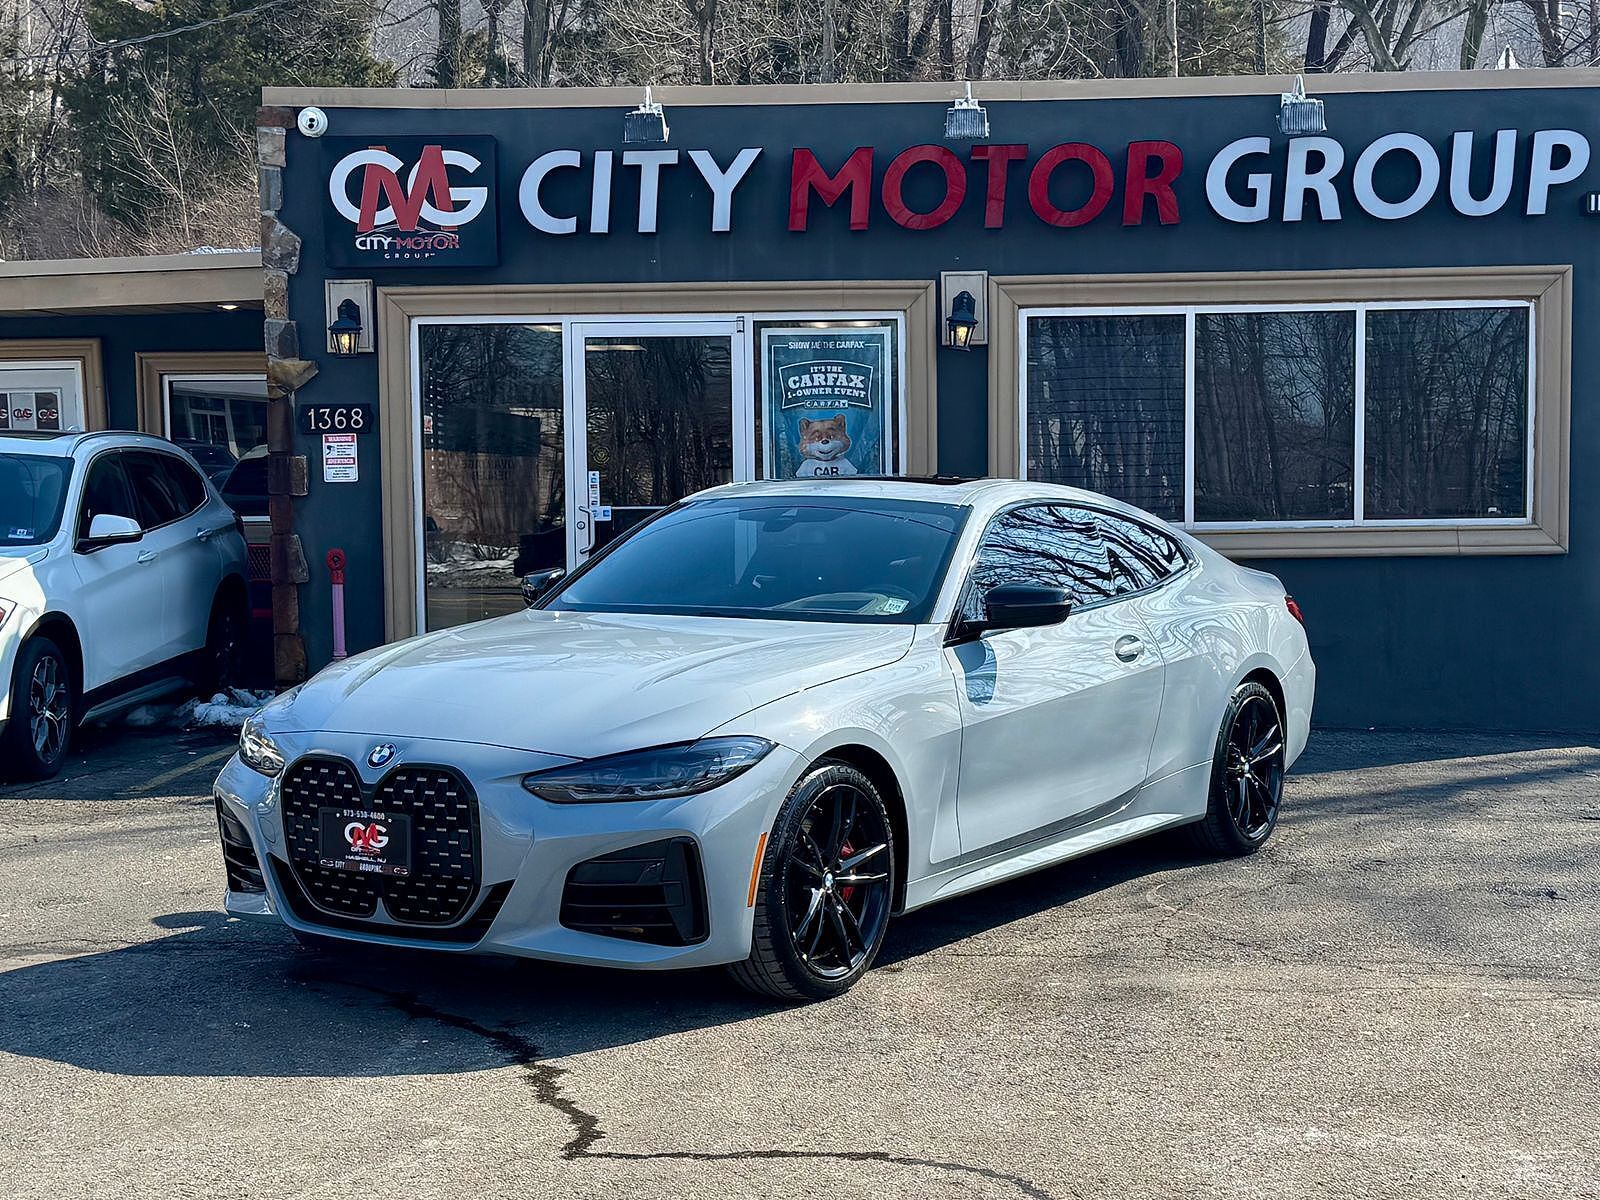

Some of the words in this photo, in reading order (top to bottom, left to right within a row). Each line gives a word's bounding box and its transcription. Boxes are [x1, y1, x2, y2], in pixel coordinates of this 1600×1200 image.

[518, 147, 763, 235] CITY
[787, 140, 1184, 232] MOTOR
[1205, 129, 1591, 223] GROUP
[355, 236, 391, 250] CITY
[395, 236, 460, 249] MOTOR
[836, 341, 865, 349] CARFAX
[788, 373, 865, 389] CARFAX
[787, 387, 833, 399] 1-OWNER
[834, 387, 866, 398] EVENT
[308, 408, 363, 429] 1368
